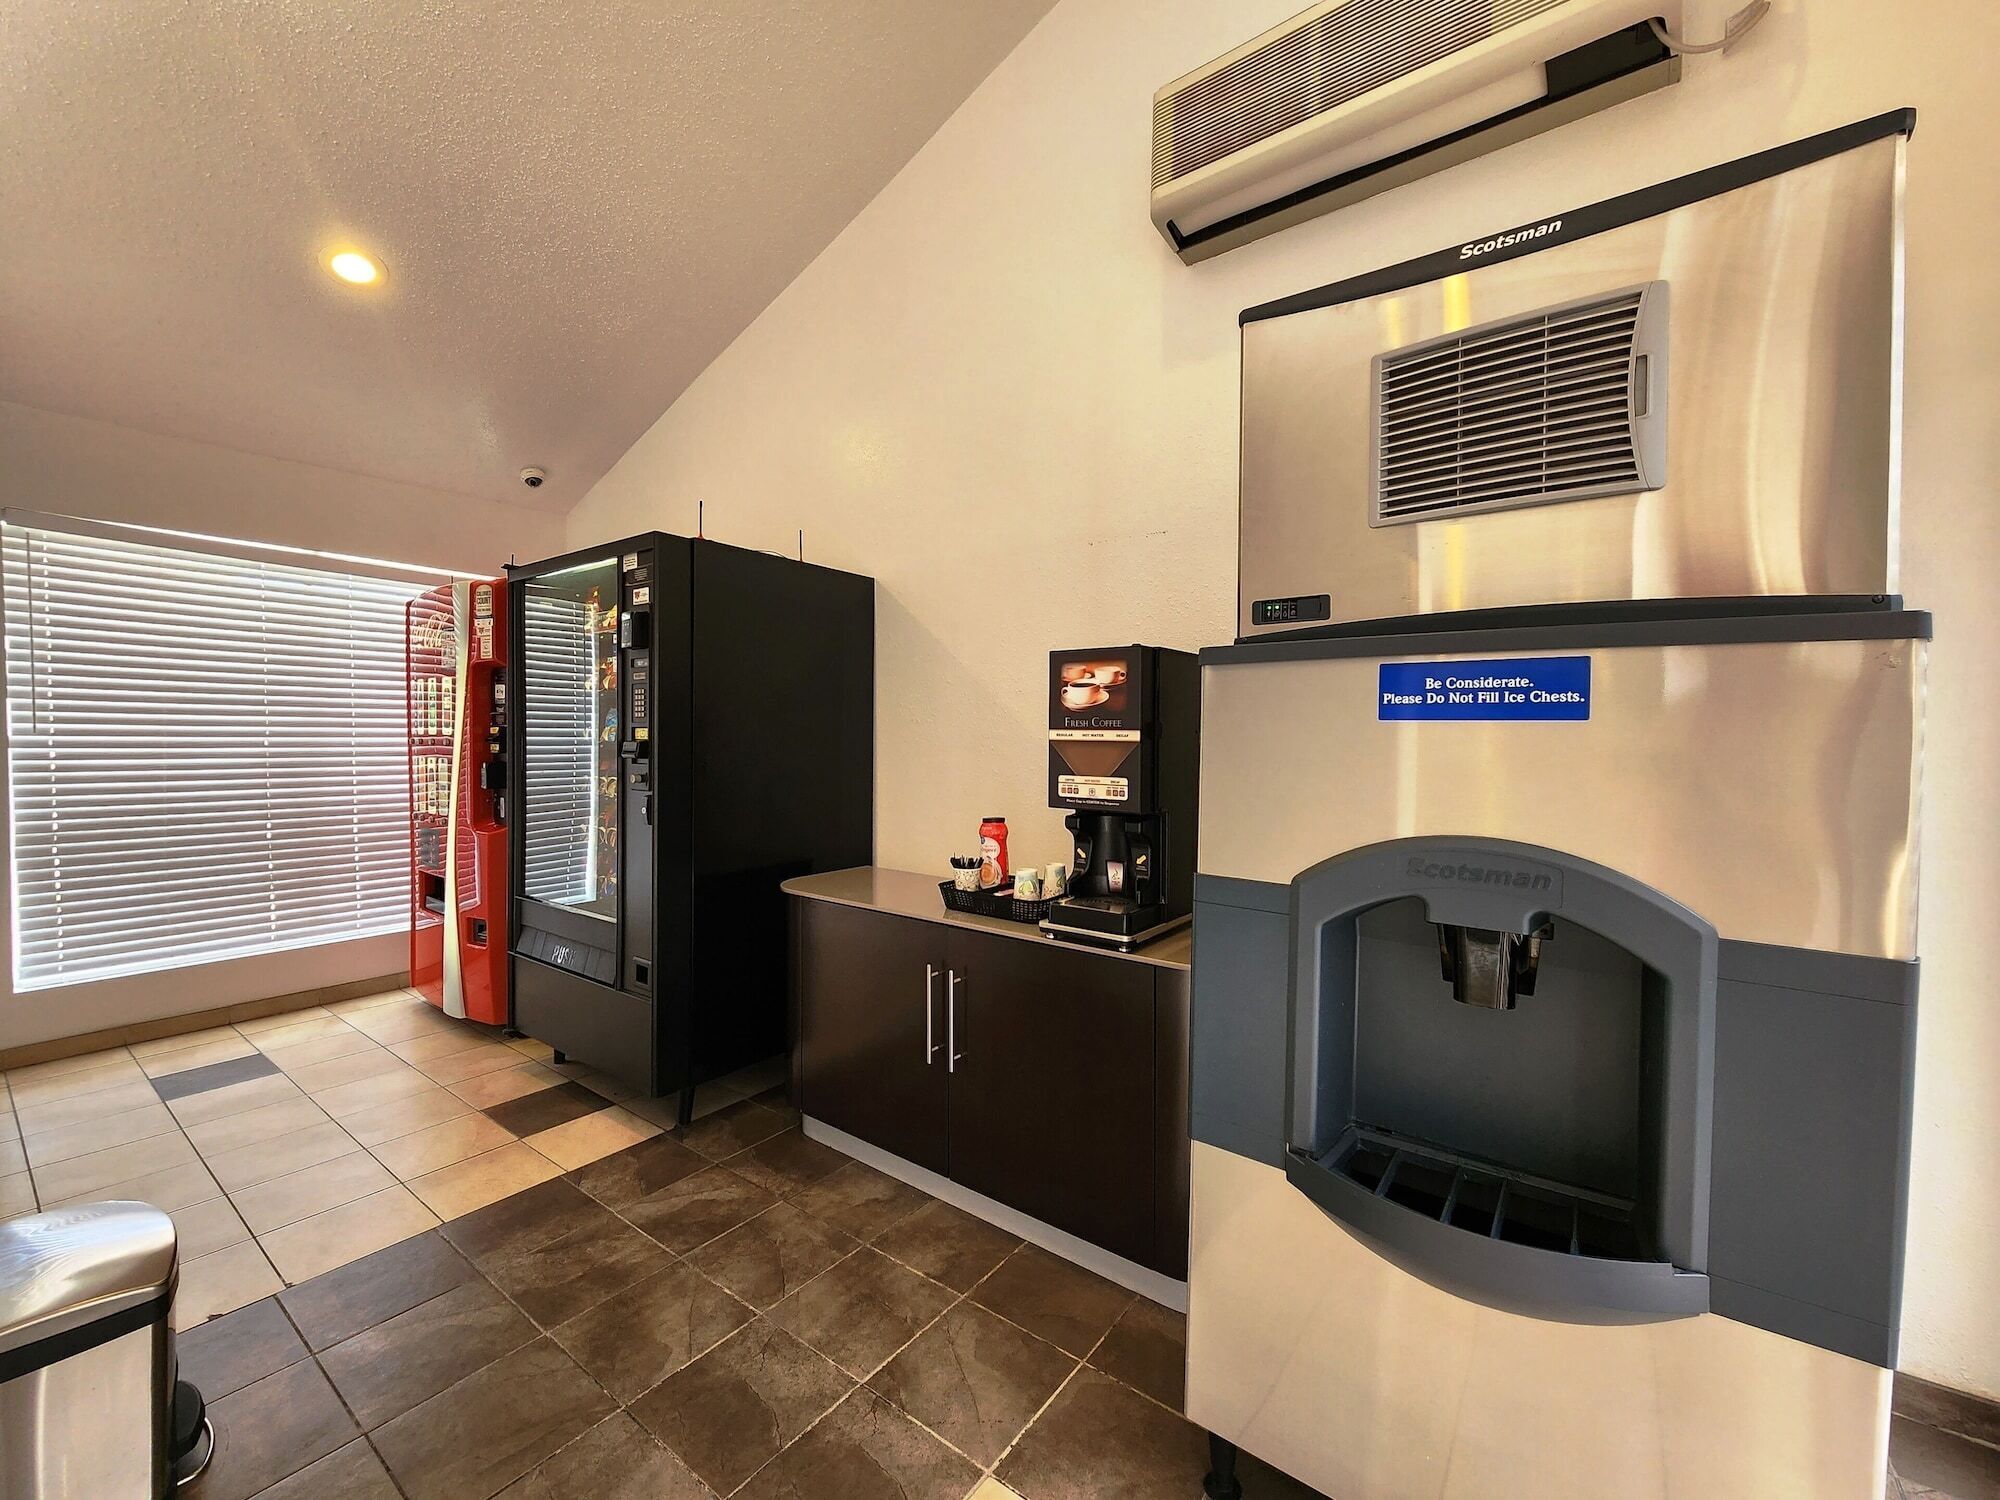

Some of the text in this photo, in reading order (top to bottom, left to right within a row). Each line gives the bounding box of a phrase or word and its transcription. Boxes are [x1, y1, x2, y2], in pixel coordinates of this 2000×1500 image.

[1459, 220, 1562, 260] Scotsman
[1425, 676, 1534, 689] Be Considerate.
[1383, 690, 1585, 704] Please Do Not Fill Ice Chests.
[1407, 857, 1551, 889] Scotsman
[551, 944, 577, 966] PUSH
